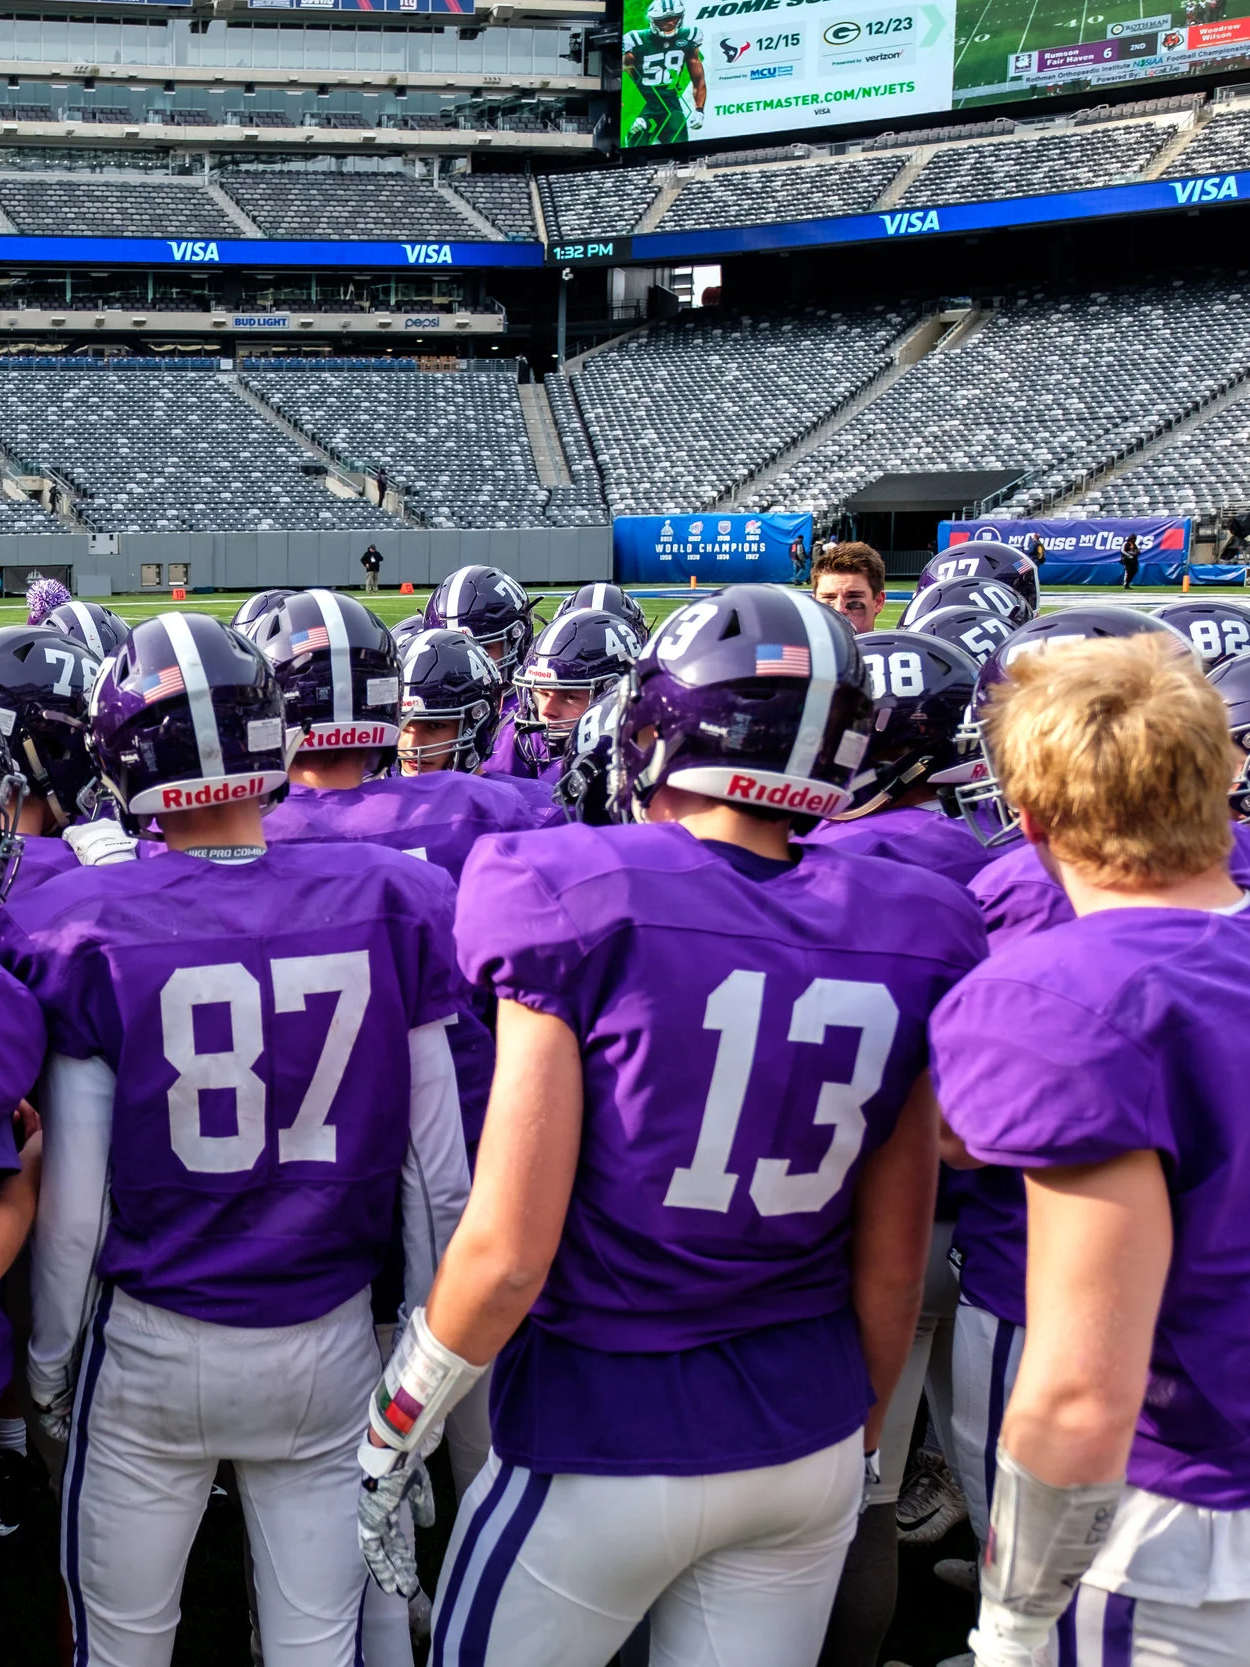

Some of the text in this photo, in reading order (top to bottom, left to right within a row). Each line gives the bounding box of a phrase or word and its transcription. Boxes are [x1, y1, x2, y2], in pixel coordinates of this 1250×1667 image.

[695, 0, 780, 21] HOME
[865, 16, 914, 36] 12/23
[1199, 24, 1242, 35] Woodrow
[756, 32, 801, 51] 12/15
[1202, 32, 1232, 41] Wilson
[1043, 49, 1080, 60] Rumson
[1102, 47, 1113, 59] 6
[1130, 42, 1147, 51] 2ND
[865, 51, 901, 63] verizon
[1046, 53, 1095, 67] Fair Haven
[750, 67, 777, 80] MCU
[1026, 73, 1055, 83] Rothman
[1167, 52, 1197, 62] Football
[1097, 74, 1127, 83] Powered
[714, 81, 916, 116] TICKETMASTER.COM/NYJETS
[814, 107, 831, 116] VISA
[1169, 175, 1238, 204] VISA
[879, 210, 940, 235] VISA
[166, 241, 220, 262] VISA
[400, 244, 452, 264] VISA
[553, 243, 614, 260] 1:32 PM
[234, 317, 288, 327] BUD LIGHT
[405, 316, 440, 330] pepsi
[655, 543, 766, 553] WORLD CHAMPIONS
[1024, 533, 1076, 550] Cuse
[1095, 531, 1154, 549] Clets
[175, 590, 184, 598] 10
[605, 624, 641, 663] 42
[1189, 620, 1250, 659] 82
[163, 776, 264, 809] Riddell
[727, 774, 841, 815] Riddell
[209, 849, 232, 857] PRO
[160, 950, 372, 1174] 87
[662, 969, 900, 1218] 13
